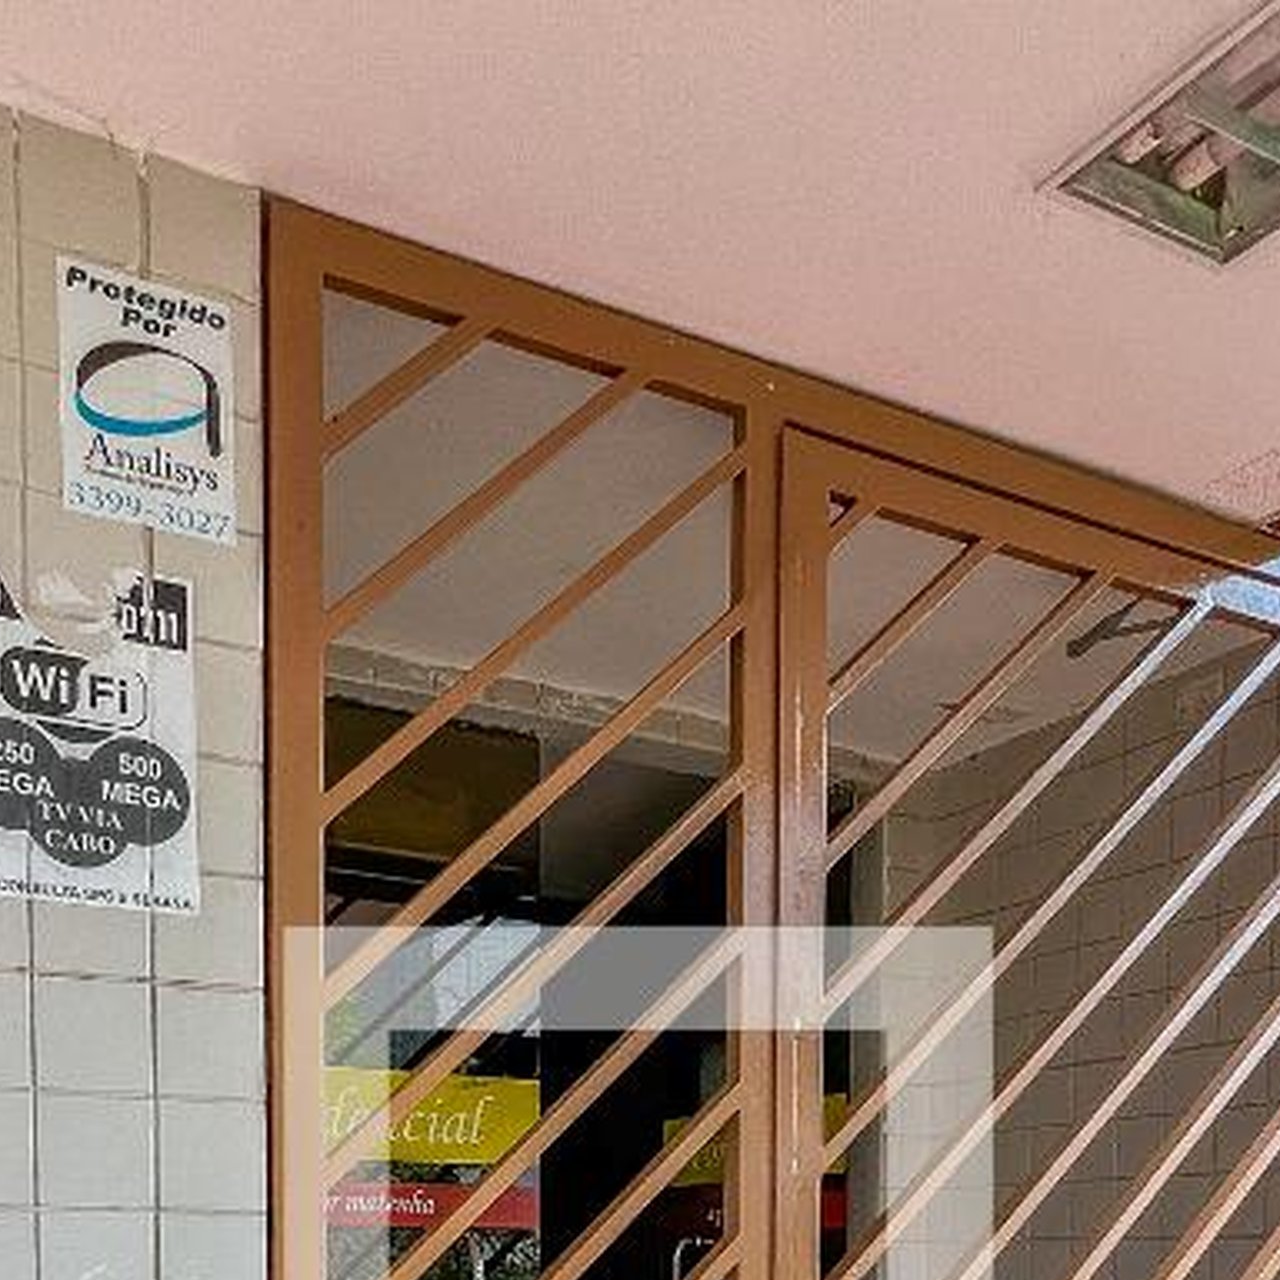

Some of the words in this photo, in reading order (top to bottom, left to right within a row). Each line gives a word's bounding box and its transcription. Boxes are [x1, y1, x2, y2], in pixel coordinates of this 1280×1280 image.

[66, 266, 226, 331] Protegido
[121, 307, 177, 338] Por
[84, 432, 220, 492] Analisys
[69, 481, 232, 539] 3399-3027
[101, 779, 182, 811] MEGA
